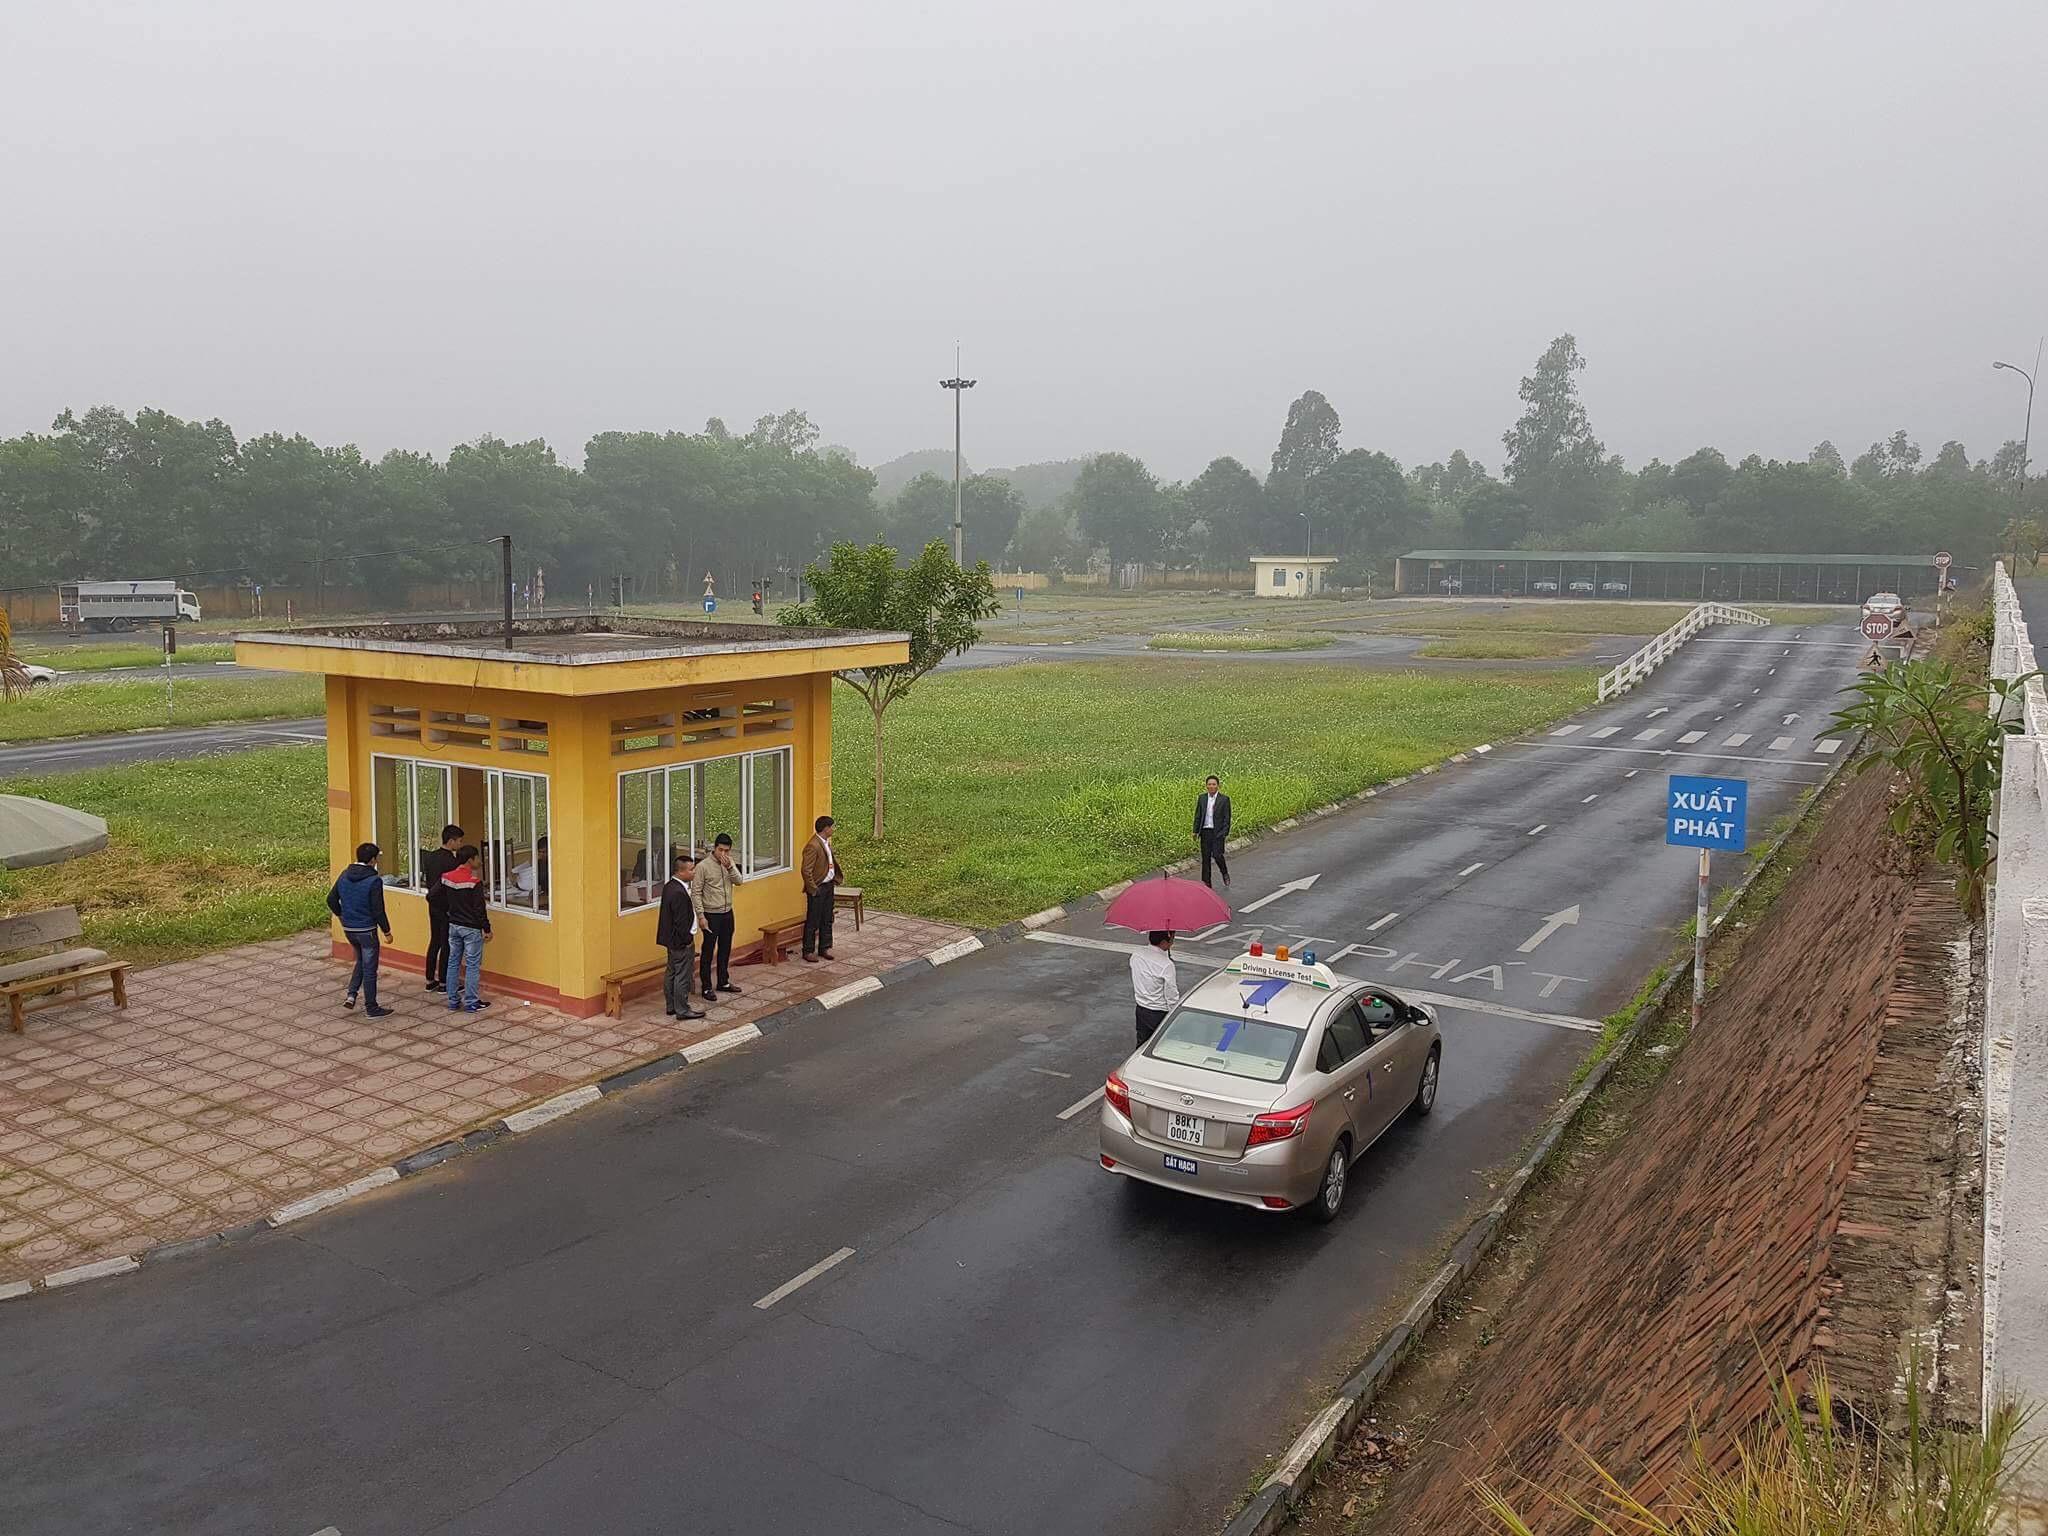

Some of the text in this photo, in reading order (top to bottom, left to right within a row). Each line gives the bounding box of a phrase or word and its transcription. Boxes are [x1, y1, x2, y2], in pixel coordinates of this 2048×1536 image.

[1935, 556, 1950, 565] STOP
[129, 584, 138, 594] 7
[1866, 622, 1889, 635] STOP
[1672, 786, 1738, 814] XUẤT
[1673, 816, 1735, 840] PHÁT
[1242, 962, 1312, 982] Driving License Test
[1216, 1021, 1241, 1052] 1
[1175, 1113, 1198, 1130] 88KT
[1170, 1128, 1201, 1144] 000.79
[1165, 1154, 1196, 1174] SÁT HẠCH
